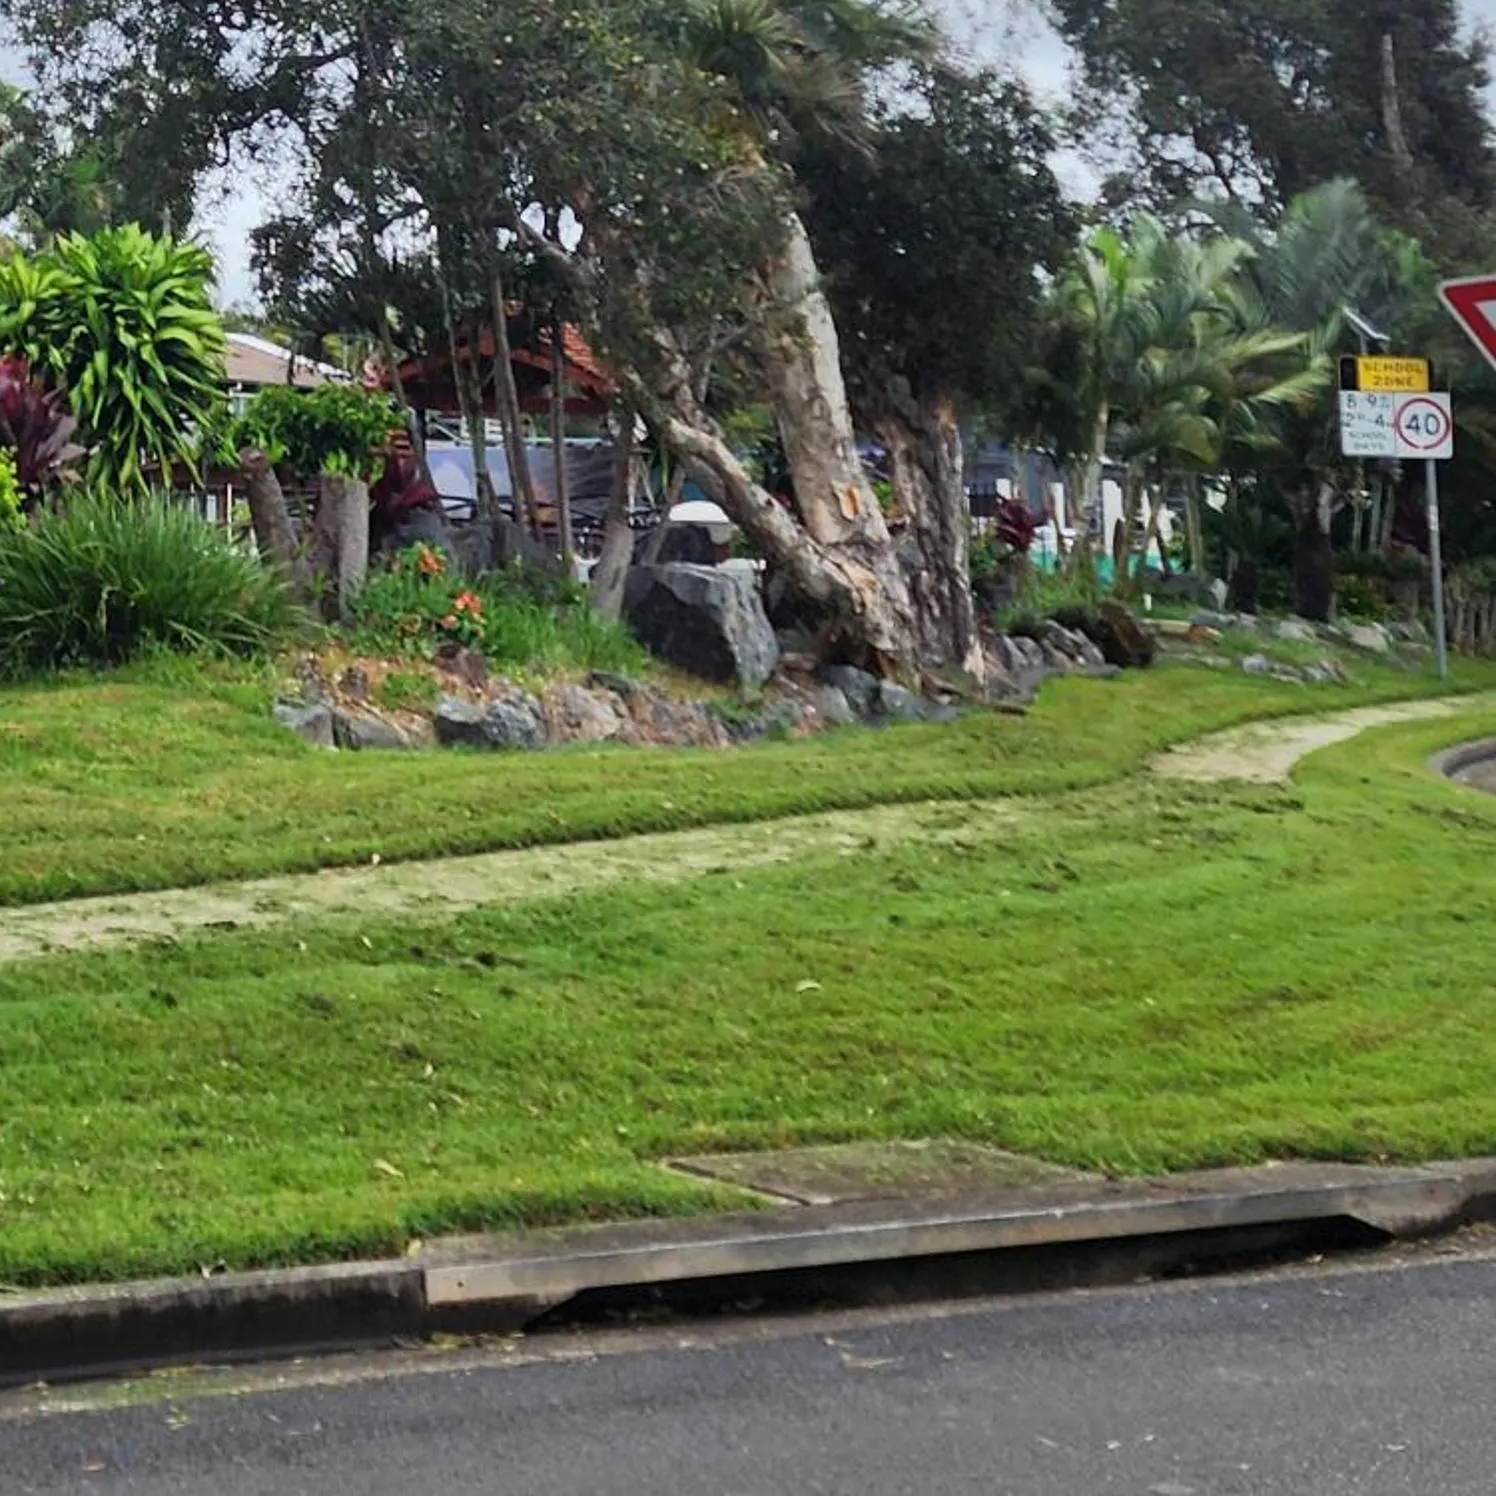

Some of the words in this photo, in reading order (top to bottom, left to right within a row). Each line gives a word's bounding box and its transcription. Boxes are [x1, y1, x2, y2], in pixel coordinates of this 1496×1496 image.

[1363, 362, 1424, 374] SCHOOL
[1372, 375, 1414, 387] ZONE
[1405, 413, 1441, 436] 40
